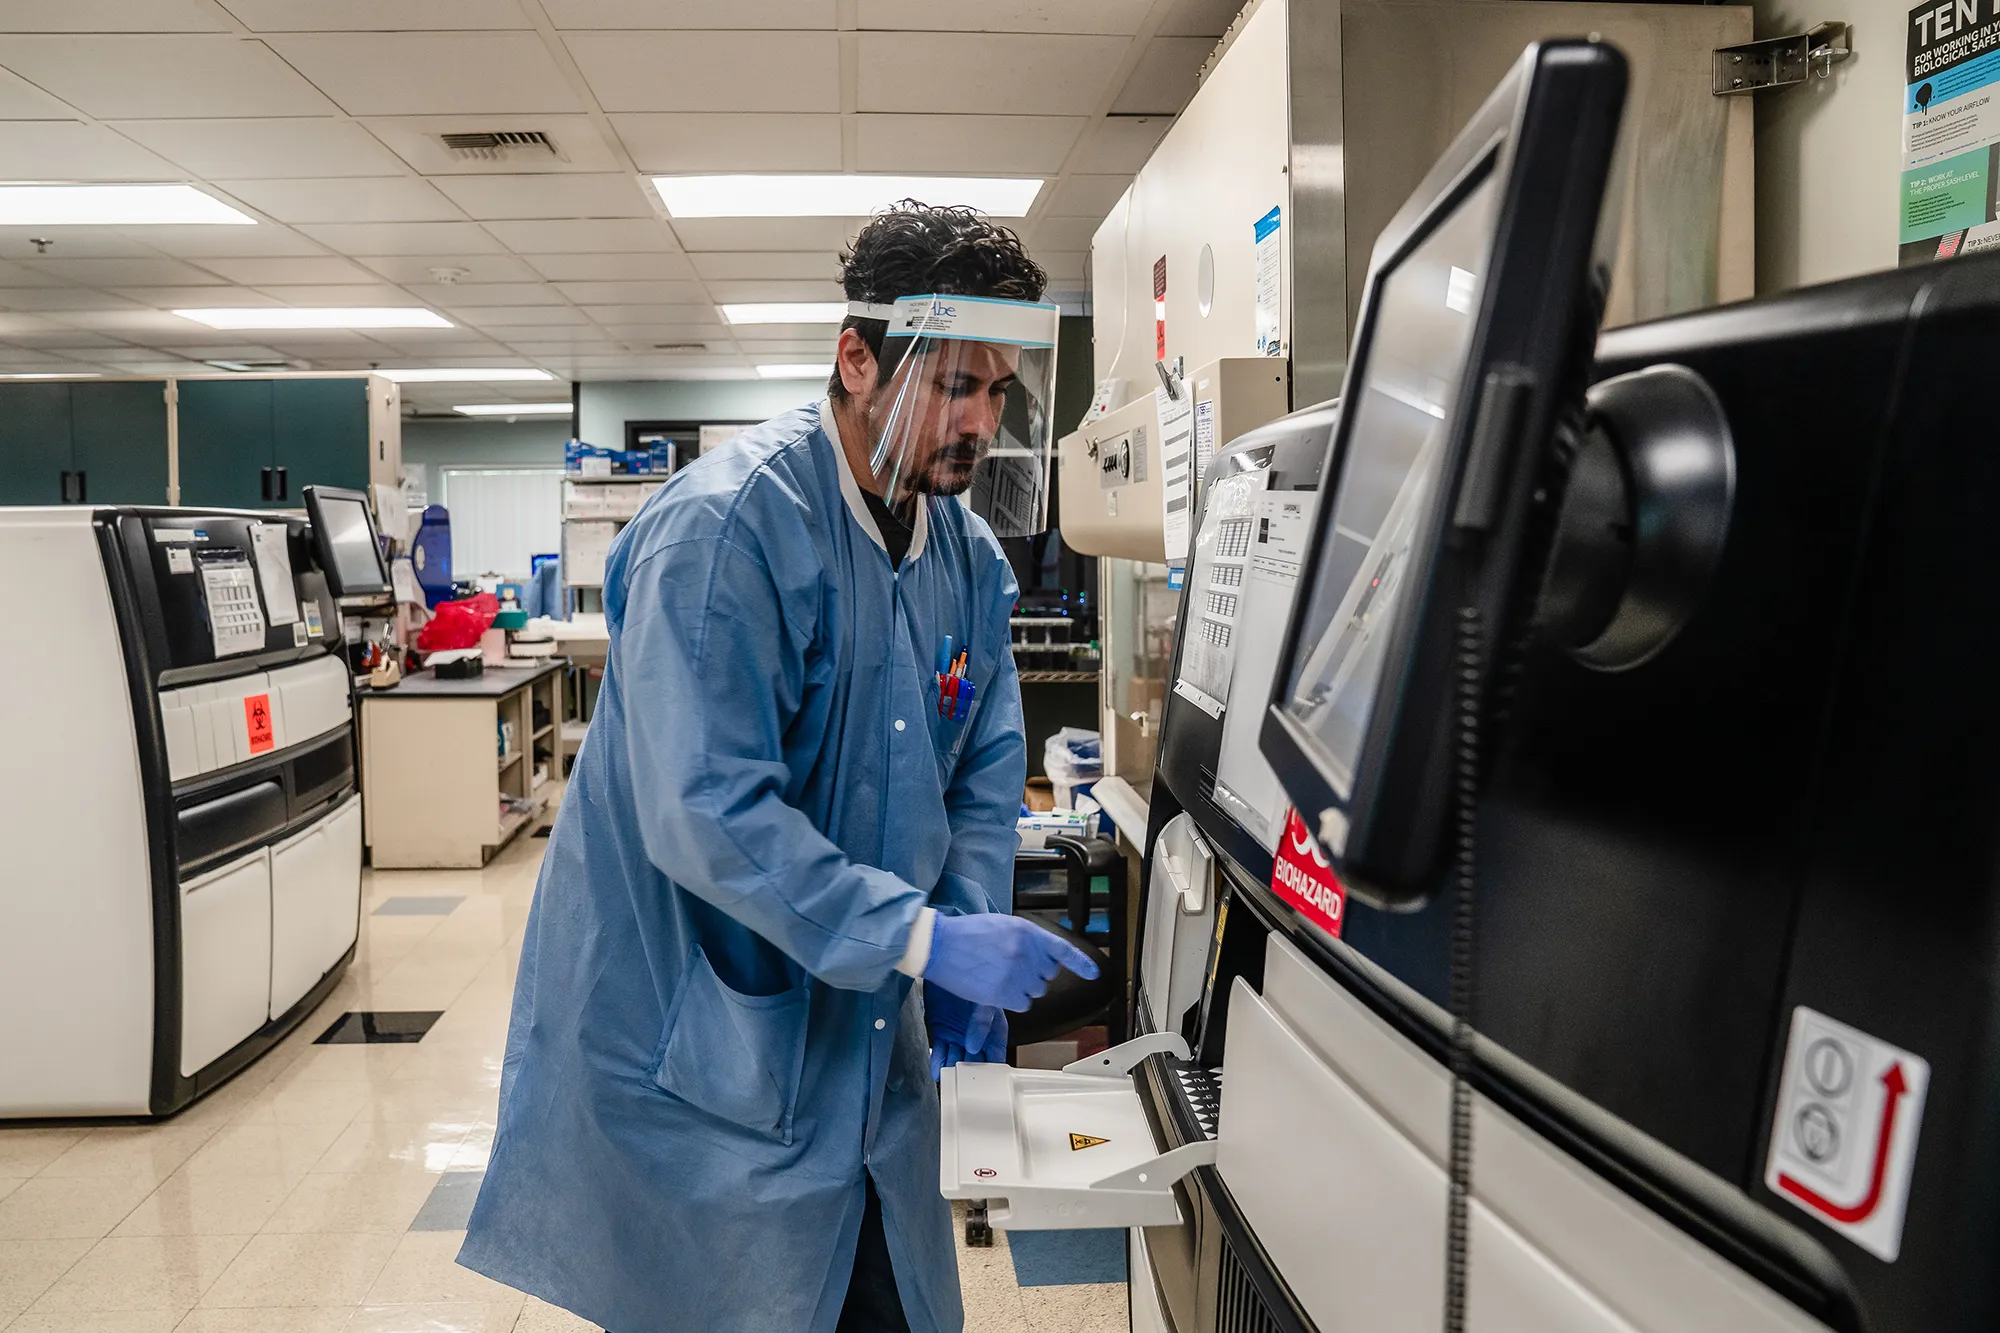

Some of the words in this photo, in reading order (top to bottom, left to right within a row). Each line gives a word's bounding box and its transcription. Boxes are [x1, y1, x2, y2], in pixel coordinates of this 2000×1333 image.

[1915, 0, 1977, 46] TEN
[1915, 51, 1932, 66] FOR
[1933, 30, 1979, 58] WORKING
[1981, 25, 1991, 38] IN
[1993, 20, 2000, 32] Y
[1914, 45, 1970, 76] BIOLOGICAL
[1912, 121, 1923, 129] TIP
[1928, 113, 1946, 124] KNOW
[1946, 107, 1963, 117] YOUR
[1963, 96, 1991, 110] AIRFLOW
[1910, 188, 1922, 196] THE
[1923, 181, 1945, 192] PROPER
[1945, 177, 1960, 186] SASH
[1961, 171, 1979, 182] LEVEL
[1928, 173, 1945, 183] WORK
[1945, 170, 1954, 178] AT
[1983, 232, 2000, 243] NEVE
[1275, 855, 1341, 921] BIOHAZARD
